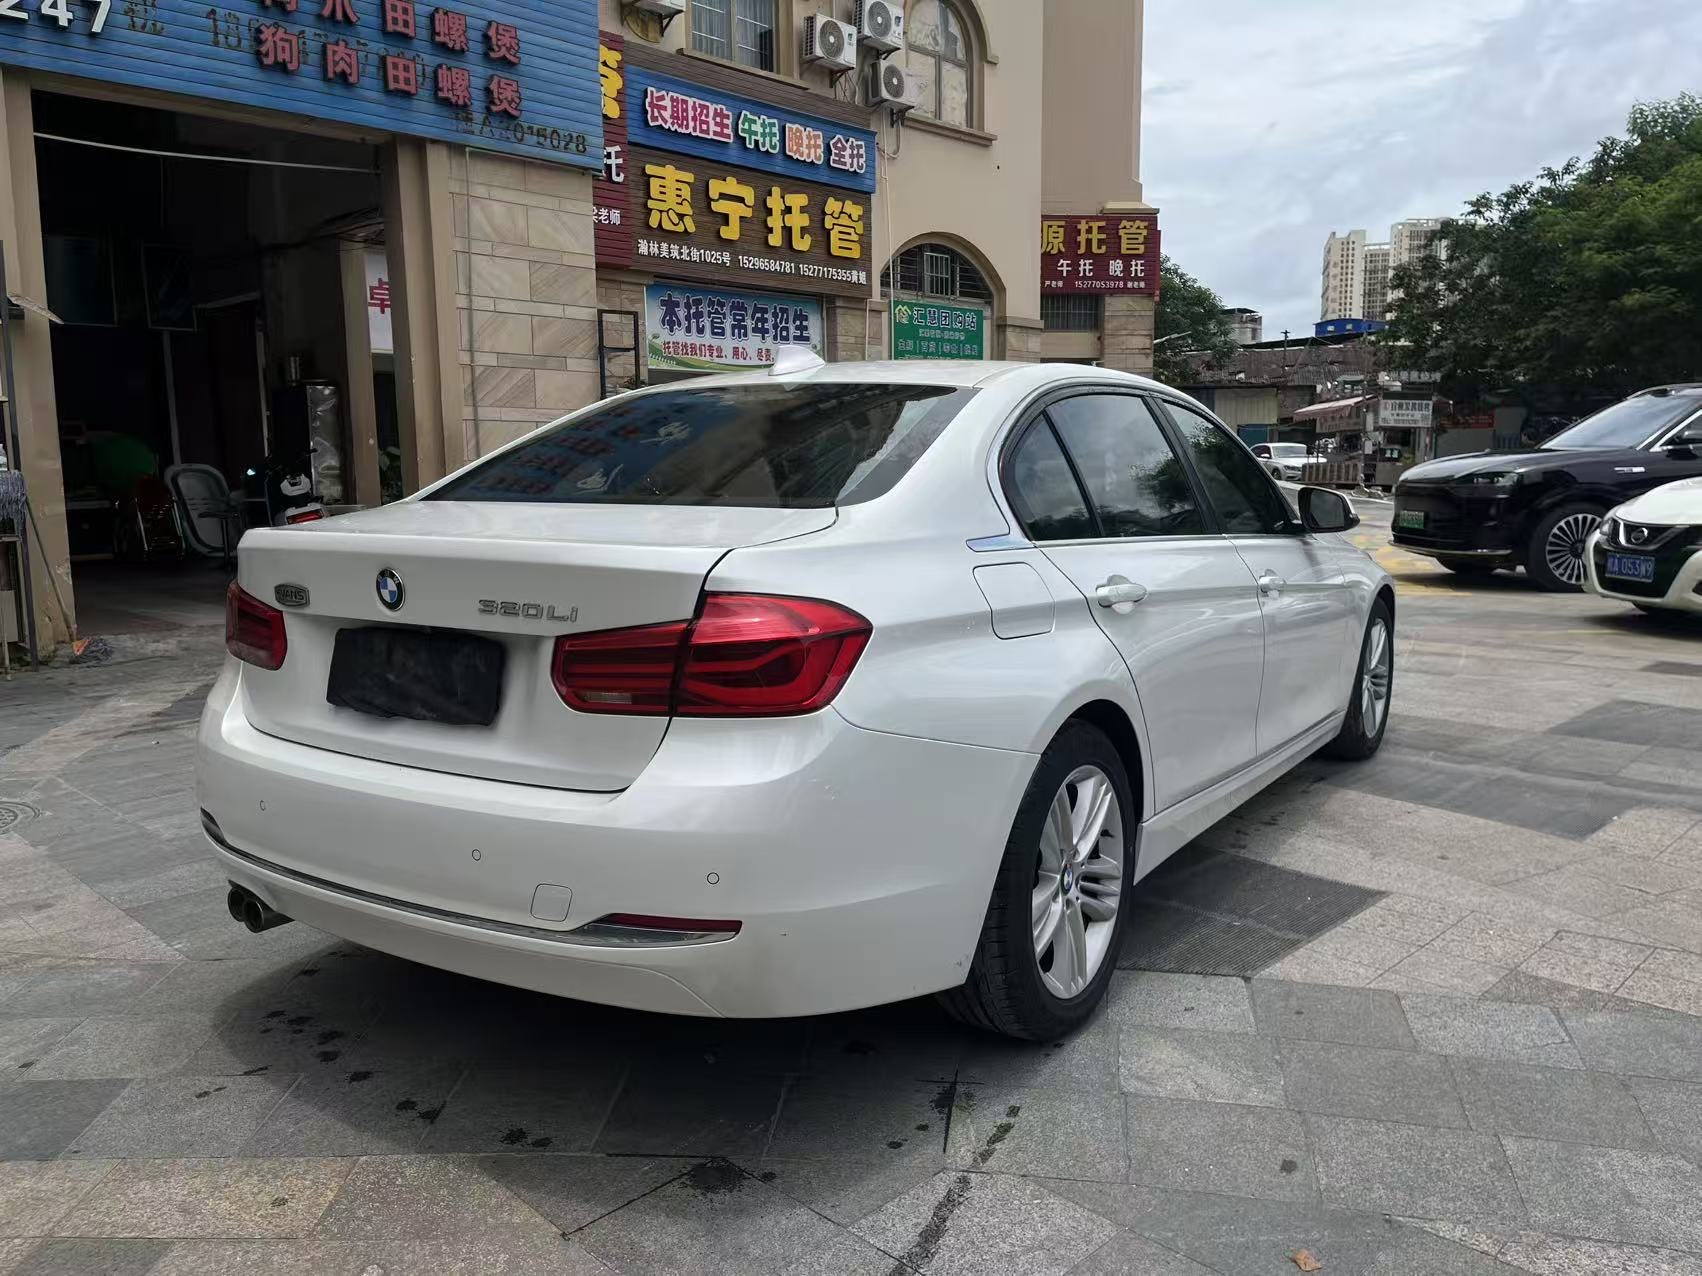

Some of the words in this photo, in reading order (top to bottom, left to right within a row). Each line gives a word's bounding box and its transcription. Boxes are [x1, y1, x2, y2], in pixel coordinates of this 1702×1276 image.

[258, 22, 522, 117] 狗肉田螺煲
[646, 87, 733, 142] 长期招生
[739, 110, 779, 153] 午托
[785, 123, 823, 164] 晚托
[829, 135, 866, 173] 全托
[645, 164, 865, 259] 惠宁托管
[1041, 220, 1149, 255] 原托管
[738, 255, 796, 275] 15296584781
[1057, 259, 1094, 277] 午托
[1109, 259, 1145, 277] 晚托
[659, 290, 811, 344] 本托管常年招生
[478, 599, 578, 623] 320Li
